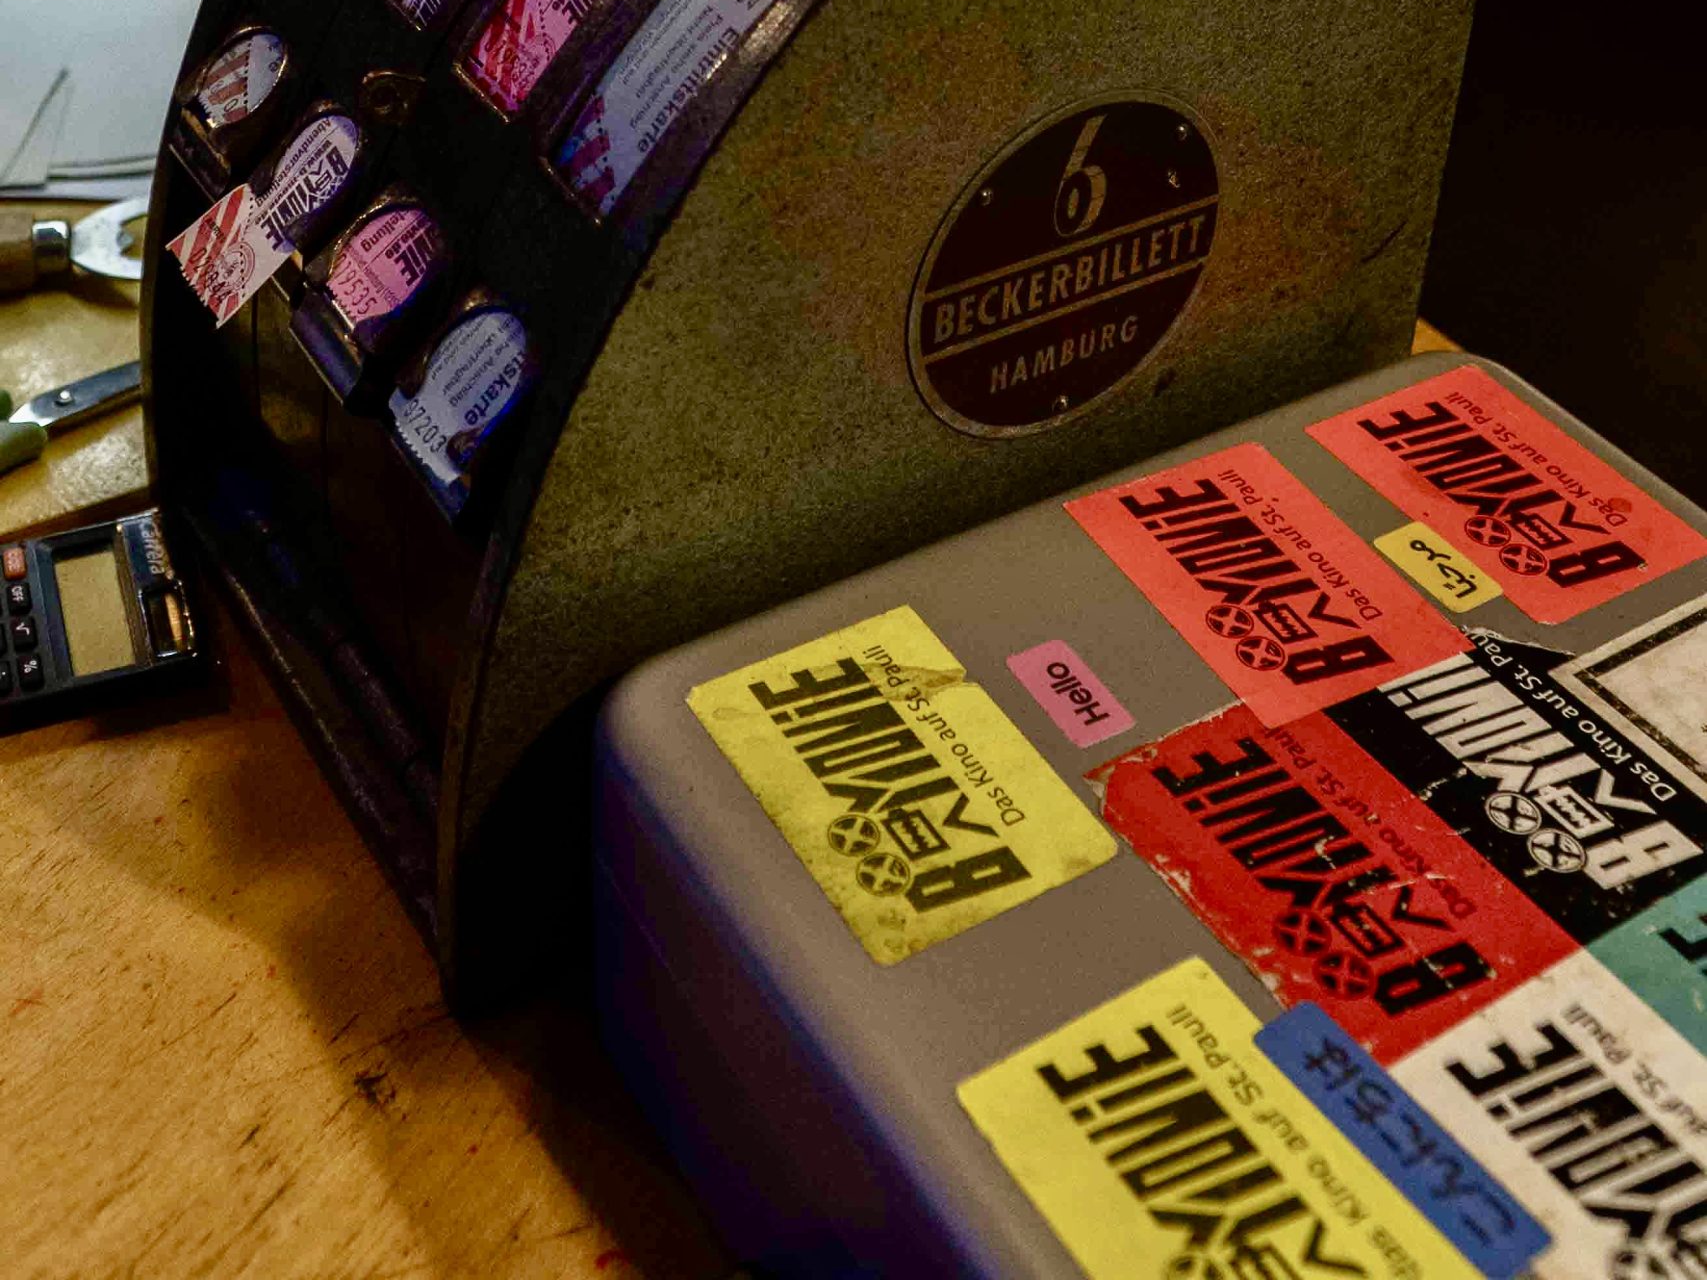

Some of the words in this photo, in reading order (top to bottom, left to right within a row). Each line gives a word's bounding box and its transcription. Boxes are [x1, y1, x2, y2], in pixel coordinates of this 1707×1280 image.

[634, 25, 741, 156] Eintrittskarte
[1054, 114, 1107, 237] 6
[933, 215, 1205, 344] BECKERBILLETT
[990, 315, 1138, 394] HAMBURG
[1444, 391, 1493, 425] Pauli
[1508, 442, 1548, 466] auf
[1218, 469, 1263, 506] Pauli
[1547, 464, 1590, 499] Kino
[1589, 498, 1627, 527] Das
[1278, 525, 1312, 551] auf
[1307, 552, 1348, 589] Kino
[1345, 588, 1383, 620] Das
[862, 645, 911, 688] Pauli
[1047, 661, 1109, 726] Hello
[1532, 688, 1580, 720] auf
[914, 710, 957, 741] auf
[1578, 720, 1632, 764] Kino
[951, 744, 996, 788] Kino
[1631, 762, 1677, 803] Das
[987, 789, 1026, 826] Das
[1166, 1004, 1231, 1070] Pauli
[1559, 1003, 1632, 1065] Pauli
